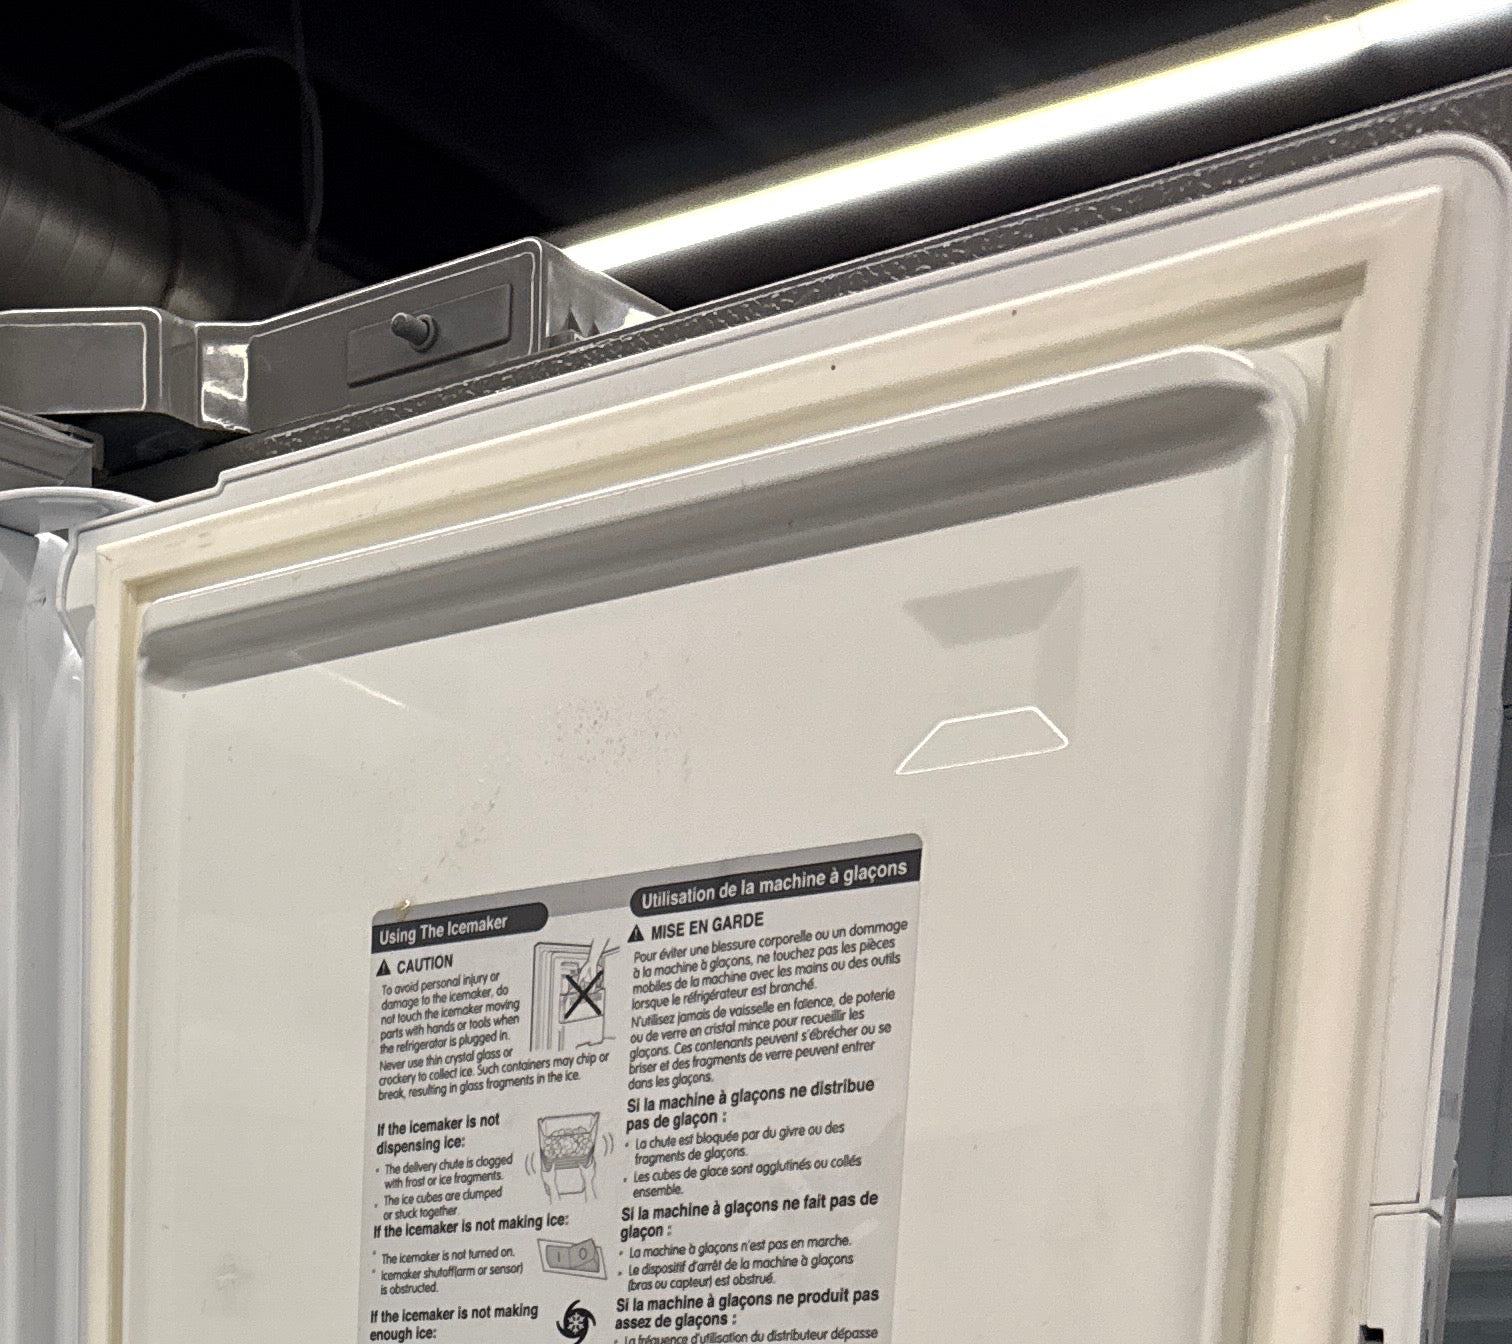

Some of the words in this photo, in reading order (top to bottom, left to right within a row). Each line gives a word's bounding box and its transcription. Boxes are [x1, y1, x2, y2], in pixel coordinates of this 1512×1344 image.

[641, 886, 716, 910] Utilisation
[718, 881, 738, 899] de
[740, 879, 755, 896] la
[759, 871, 827, 894] machine
[829, 866, 840, 885] à
[843, 861, 908, 887] glaçons
[379, 927, 417, 946] Using
[419, 923, 445, 940] The
[447, 915, 509, 937] Icemaker
[651, 921, 686, 941] MISE
[688, 918, 709, 936] EN
[711, 911, 765, 933] GARDE
[396, 953, 454, 975] CAUTION
[626, 1097, 641, 1114] Si
[643, 1096, 656, 1112] la
[658, 1091, 716, 1111] machine
[718, 1089, 728, 1106] à
[730, 1087, 786, 1108] glaçons
[789, 1085, 808, 1099] ne
[810, 1078, 875, 1097] distribue
[376, 1122, 386, 1137] If
[387, 1121, 407, 1136] the
[409, 1116, 464, 1134] icemaker
[465, 1114, 477, 1129] is
[479, 1112, 501, 1128] not
[625, 1117, 650, 1135] pas
[652, 1113, 671, 1129] de
[672, 1111, 719, 1131] glaçon
[376, 1137, 441, 1158] dispensing
[443, 1135, 466, 1150] ice:
[621, 1206, 635, 1222] Si
[637, 1205, 650, 1221] la
[652, 1202, 710, 1220] machine
[711, 1200, 721, 1216] à
[724, 1199, 779, 1218] glaçons
[782, 1198, 801, 1211] ne
[803, 1193, 827, 1210] fait
[829, 1194, 857, 1212] pas
[859, 1190, 879, 1207] de
[373, 1224, 382, 1239] If
[383, 1224, 403, 1239] the
[405, 1220, 459, 1237] icemaker
[461, 1218, 473, 1233] is
[475, 1217, 496, 1232] not
[498, 1214, 544, 1231] making
[546, 1213, 570, 1227] ice:
[619, 1224, 664, 1243] glaçon
[616, 1297, 630, 1313] Si
[632, 1297, 645, 1312] la
[646, 1294, 704, 1312] machine
[706, 1292, 715, 1309] à
[718, 1292, 773, 1310] glaçons
[776, 1293, 795, 1306] ne
[796, 1287, 850, 1307] produit
[852, 1289, 880, 1305] pas
[370, 1309, 379, 1324] If
[380, 1309, 400, 1324] the
[401, 1307, 456, 1323] icemaker
[457, 1306, 469, 1320] is
[471, 1305, 492, 1320] not
[493, 1303, 539, 1320] making
[614, 1317, 652, 1330] assez
[654, 1313, 672, 1329] de
[674, 1313, 729, 1331] glaçons
[369, 1326, 413, 1343] enough
[415, 1325, 437, 1340] ice:
